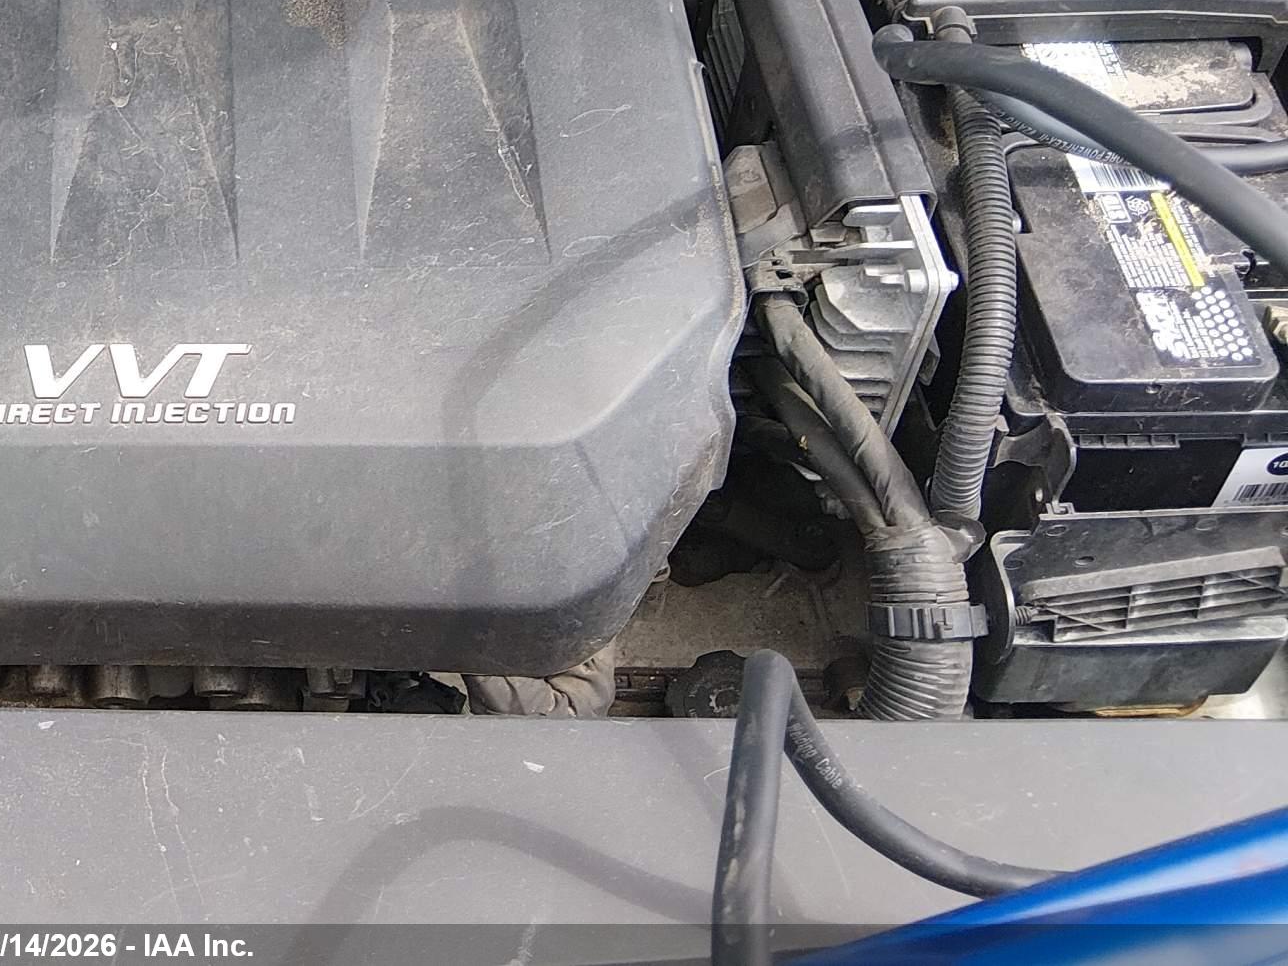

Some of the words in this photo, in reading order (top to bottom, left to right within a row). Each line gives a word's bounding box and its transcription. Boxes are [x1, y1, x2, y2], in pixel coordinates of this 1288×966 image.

[23, 343, 253, 399] VVT
[110, 402, 296, 425] INJECTION
[815, 757, 843, 789] Cable
